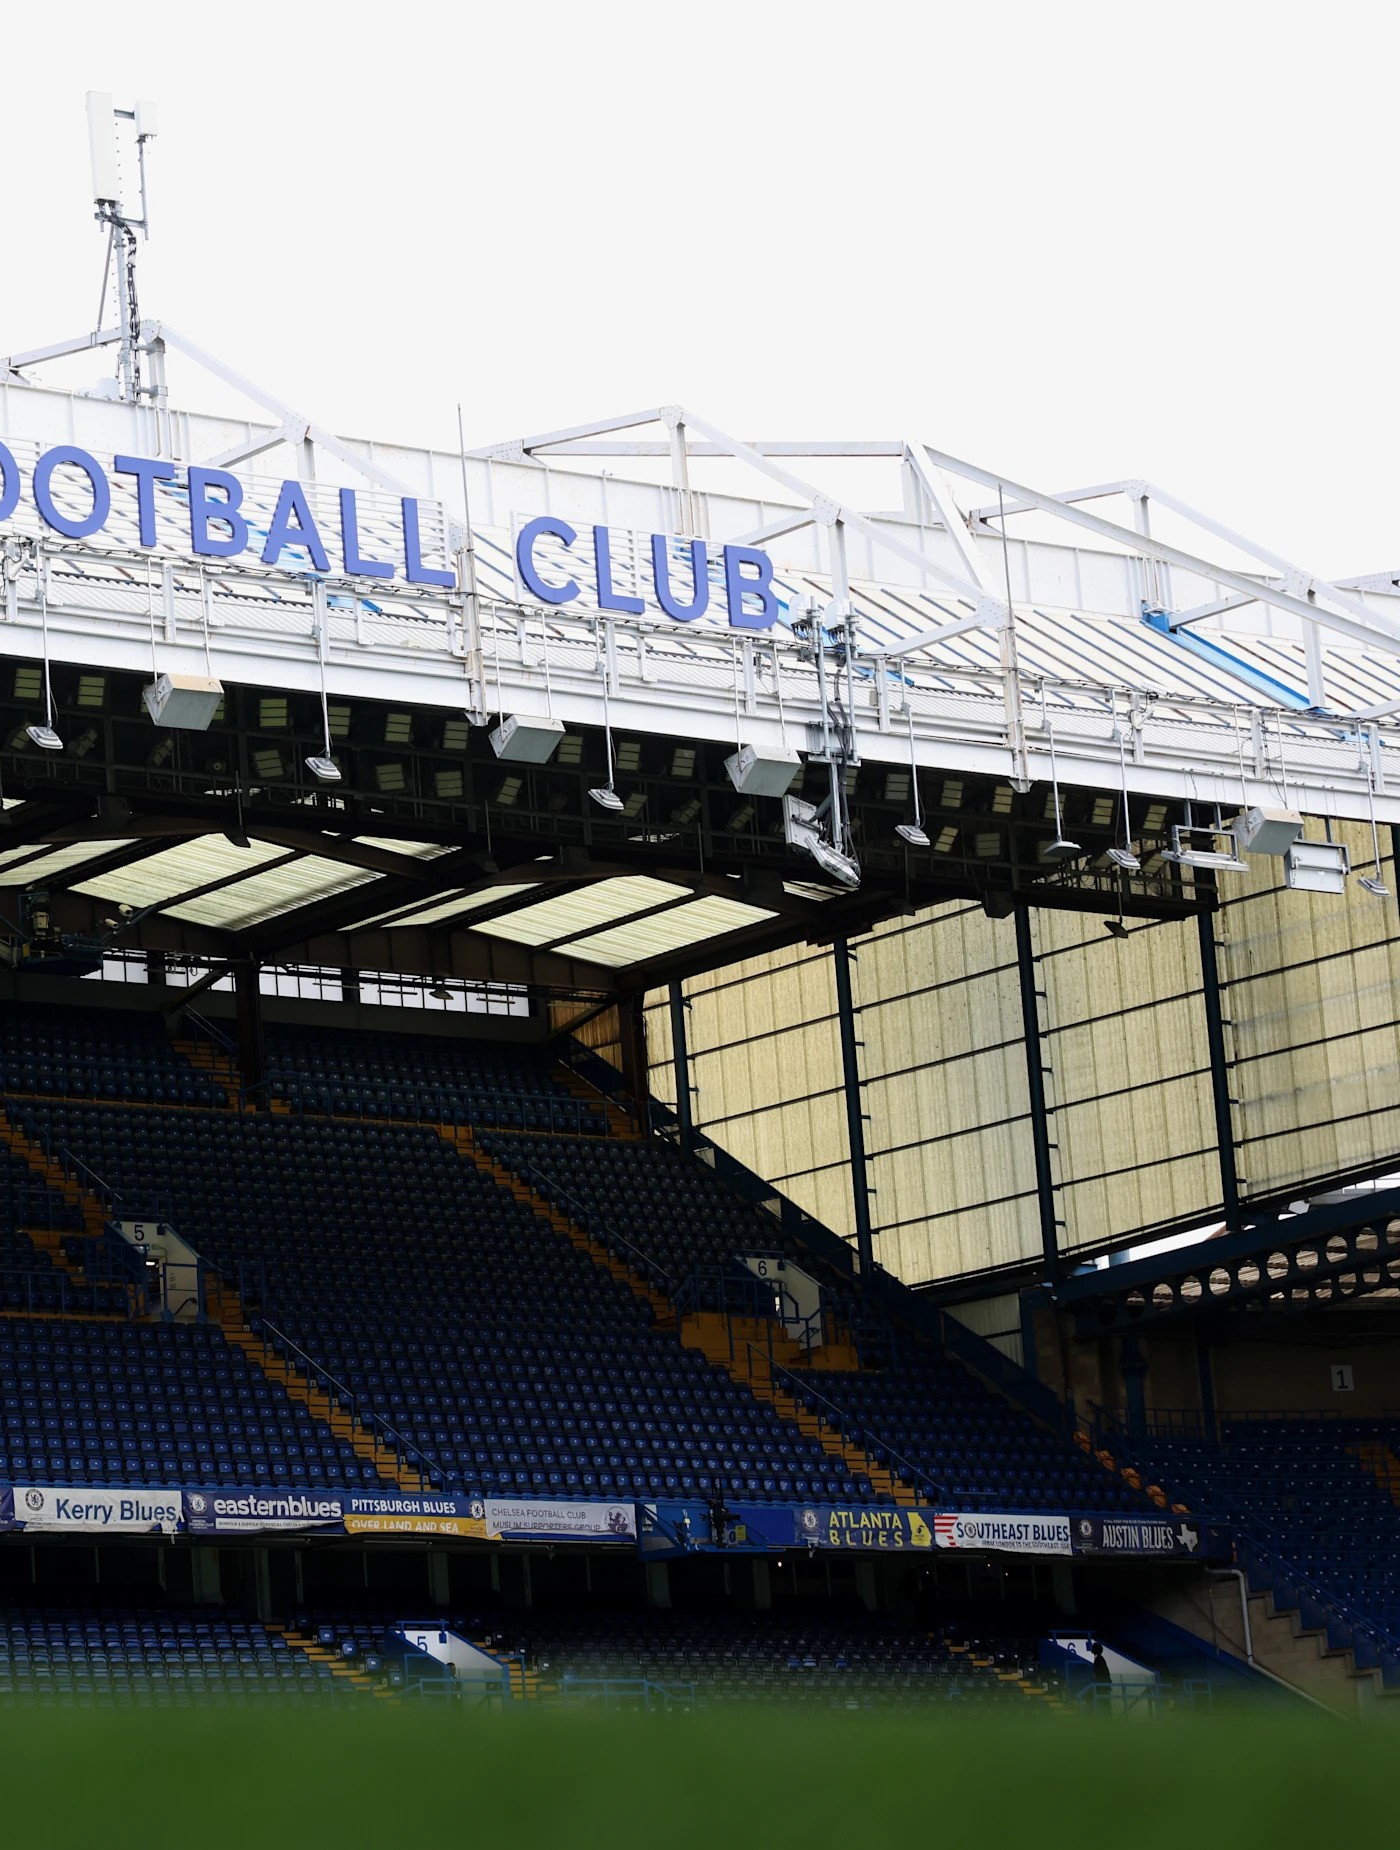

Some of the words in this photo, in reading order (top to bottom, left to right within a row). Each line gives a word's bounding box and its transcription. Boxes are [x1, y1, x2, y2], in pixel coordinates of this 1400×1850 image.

[516, 516, 790, 630] CLUB
[134, 1224, 145, 1241] 5
[758, 1260, 767, 1276] 6
[1336, 1369, 1349, 1389] 1
[56, 1498, 113, 1524] Kerry
[120, 1500, 177, 1521] Blues
[213, 1494, 341, 1517] easternblues
[352, 1499, 420, 1513] PITTSBURGH
[423, 1501, 456, 1514] BLUES
[492, 1508, 525, 1517] CHELSEA
[527, 1509, 565, 1518] FOOTBALL
[567, 1511, 587, 1519] CLUB
[415, 1522, 437, 1531] AND
[440, 1523, 460, 1533] SEA
[492, 1521, 522, 1529] MUSLIM
[524, 1522, 572, 1530] SUPPORTERS
[574, 1523, 600, 1531] GROUP
[829, 1511, 903, 1529] ATLANTA
[829, 1529, 904, 1547] BLUES
[1033, 1524, 1069, 1541] BLUES
[1102, 1525, 1140, 1548] AUSTIN
[1141, 1526, 1174, 1550] BLUES
[417, 1635, 428, 1652] 5
